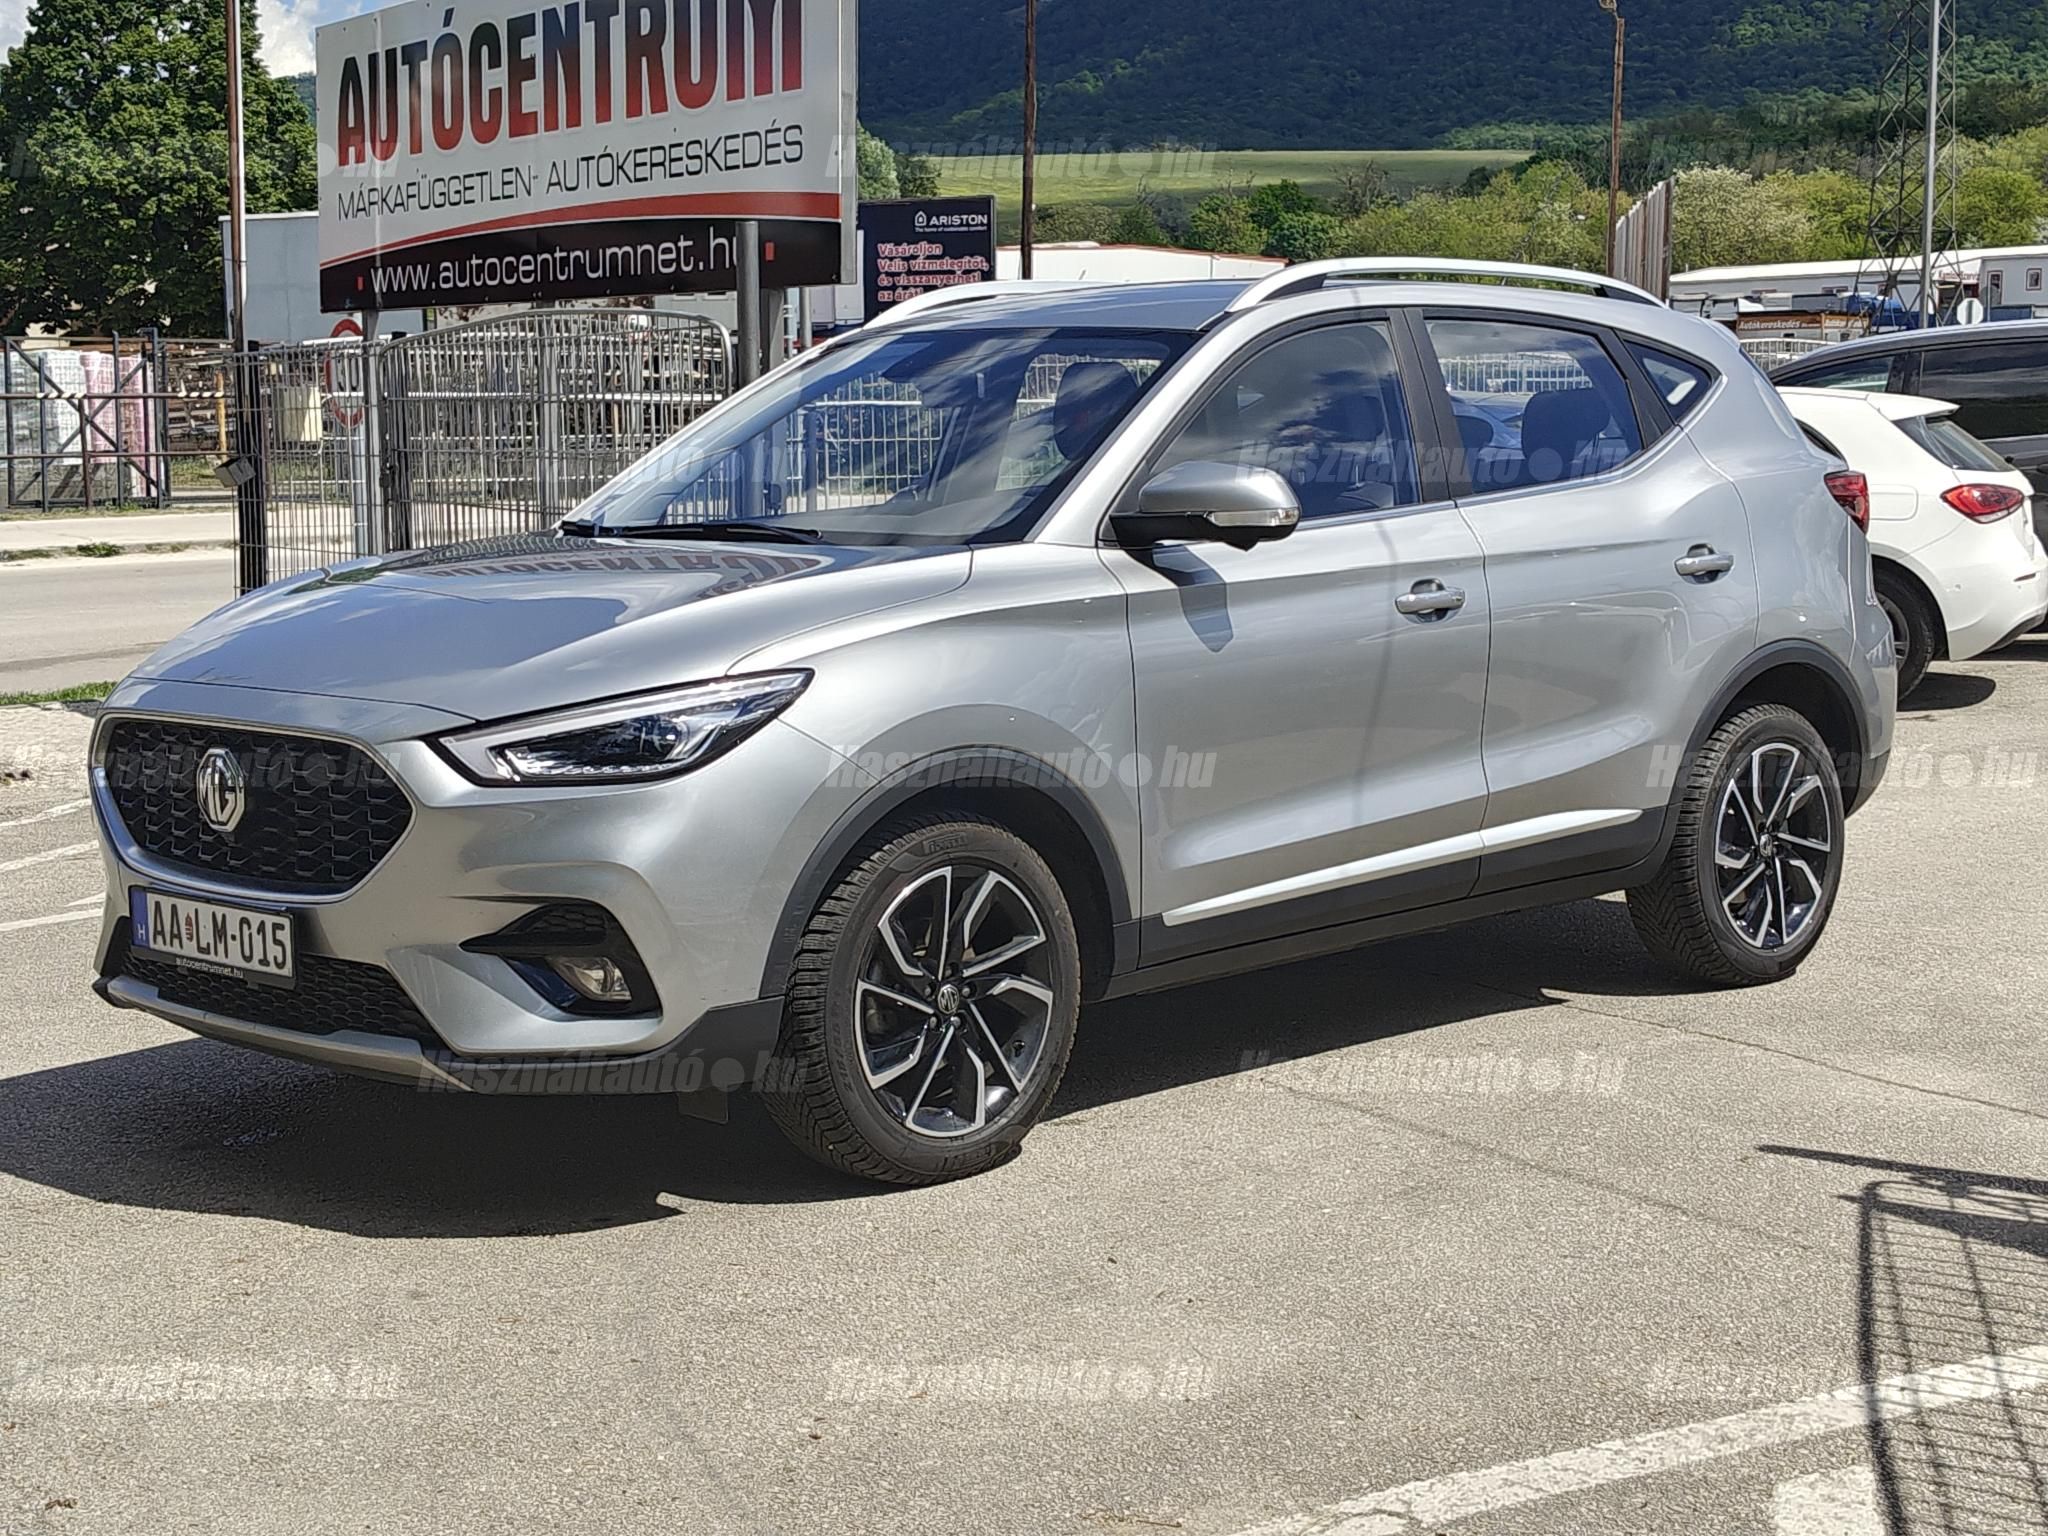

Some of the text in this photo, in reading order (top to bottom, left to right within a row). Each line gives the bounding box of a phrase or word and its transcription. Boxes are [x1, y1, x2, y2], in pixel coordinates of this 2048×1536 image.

[338, 0, 803, 167] AUTÓCENTRUM
[546, 119, 803, 194] AUTÓKERESKEDÉS
[929, 214, 988, 226] ARISTON
[371, 226, 737, 293] www.autocentrumnet.h
[877, 259, 907, 271] Velis
[877, 274, 892, 286] és
[877, 290, 893, 301] az
[199, 750, 244, 830] MG
[137, 923, 146, 941] H
[153, 901, 184, 950] AA
